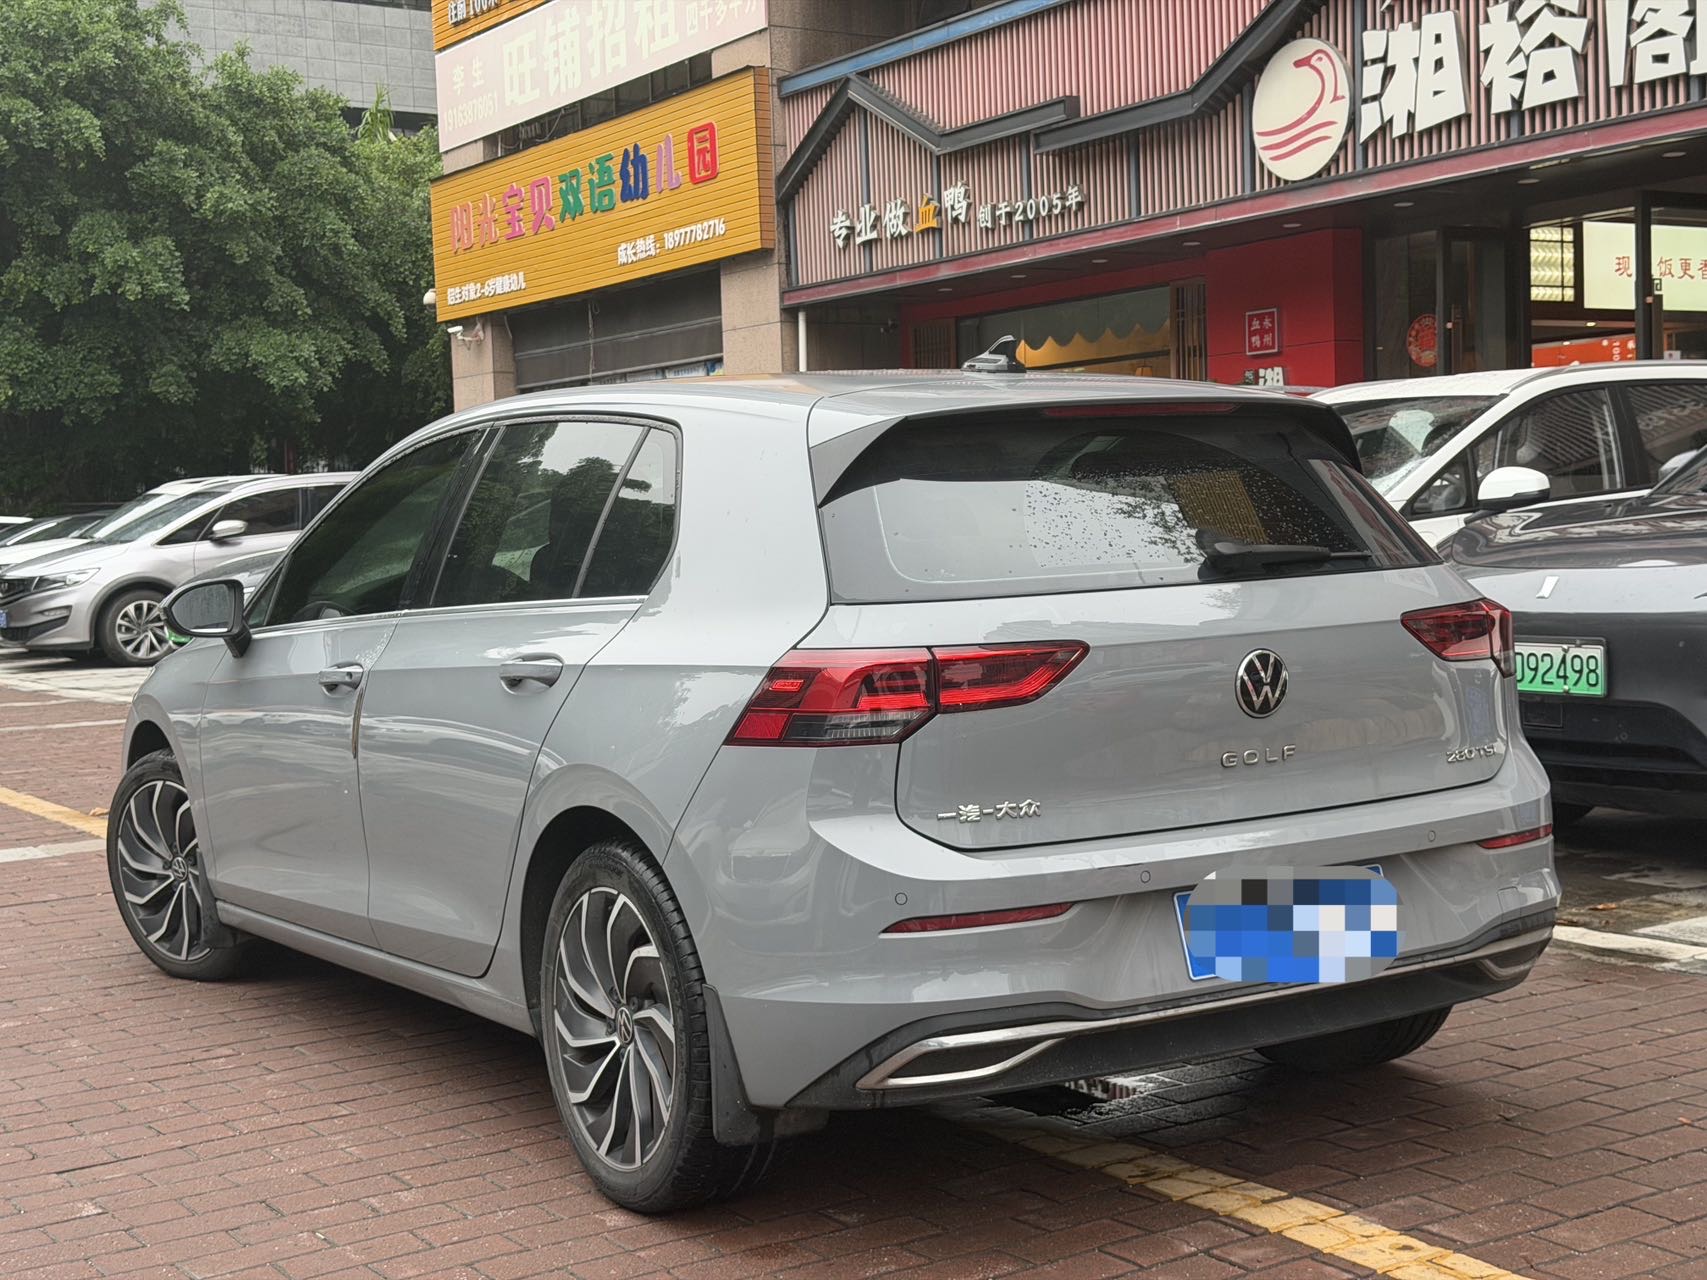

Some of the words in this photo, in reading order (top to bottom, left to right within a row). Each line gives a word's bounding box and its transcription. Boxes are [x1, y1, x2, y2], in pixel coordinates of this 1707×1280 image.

[503, 0, 680, 106] 旺铺招租
[450, 121, 720, 254] 阳光宝贝双语幼儿园
[664, 218, 726, 250] 18977782716
[830, 181, 971, 249] 专业做血鸭
[978, 185, 1084, 229] 创于2005年
[1614, 255, 1707, 280] 现饭更香
[1222, 745, 1296, 767] GOLF
